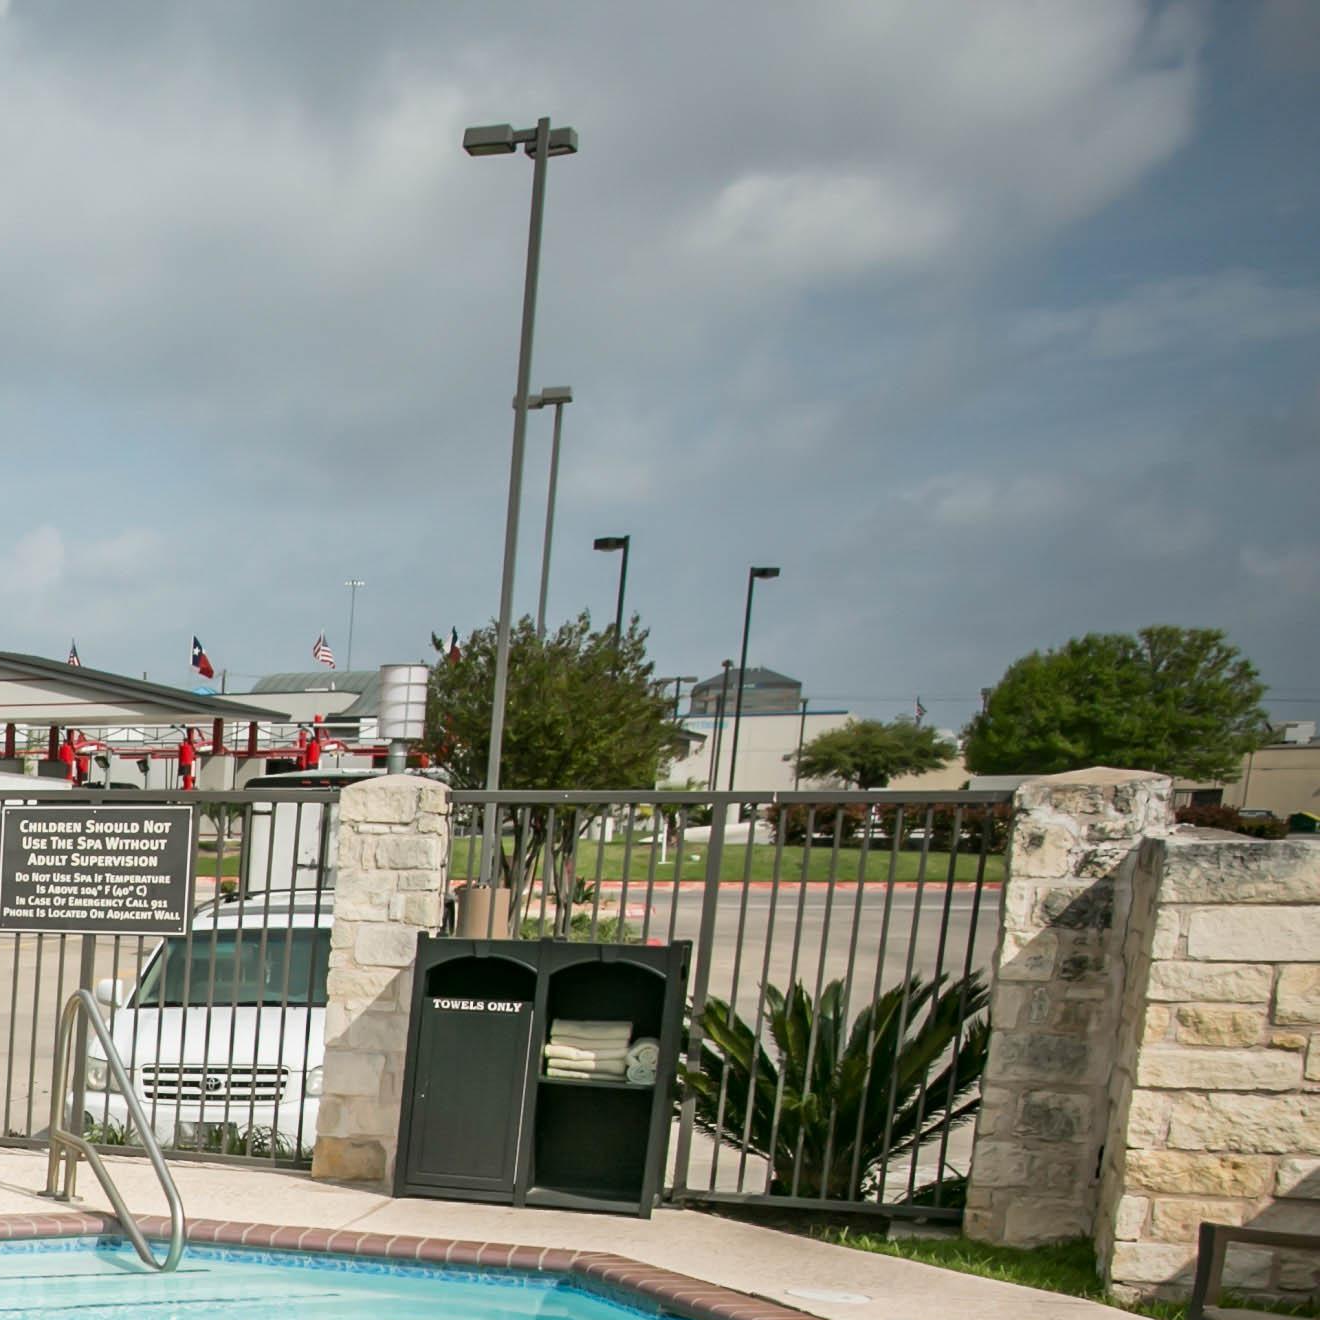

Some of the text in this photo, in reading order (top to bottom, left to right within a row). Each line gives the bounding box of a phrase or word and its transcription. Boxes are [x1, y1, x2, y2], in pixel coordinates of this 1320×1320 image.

[19, 819, 172, 834] CHILDREN SHOULD NOT
[22, 836, 168, 851] USE THE SPA WITHOUT
[27, 853, 158, 867] ADULT SUPERVISION
[15, 872, 171, 884] DO NOT USE SPA IF TEMPERATURE
[36, 885, 46, 894] IS
[47, 885, 78, 895] ABOVE
[104, 886, 111, 895] F
[136, 885, 148, 897] C)
[15, 896, 168, 909] IN CASE OF EMERGENCY CALL 911
[3, 908, 180, 921] PHONE IS LOCATED ON ADJACENT WALL
[433, 998, 523, 1013] TOWELS ONLY
